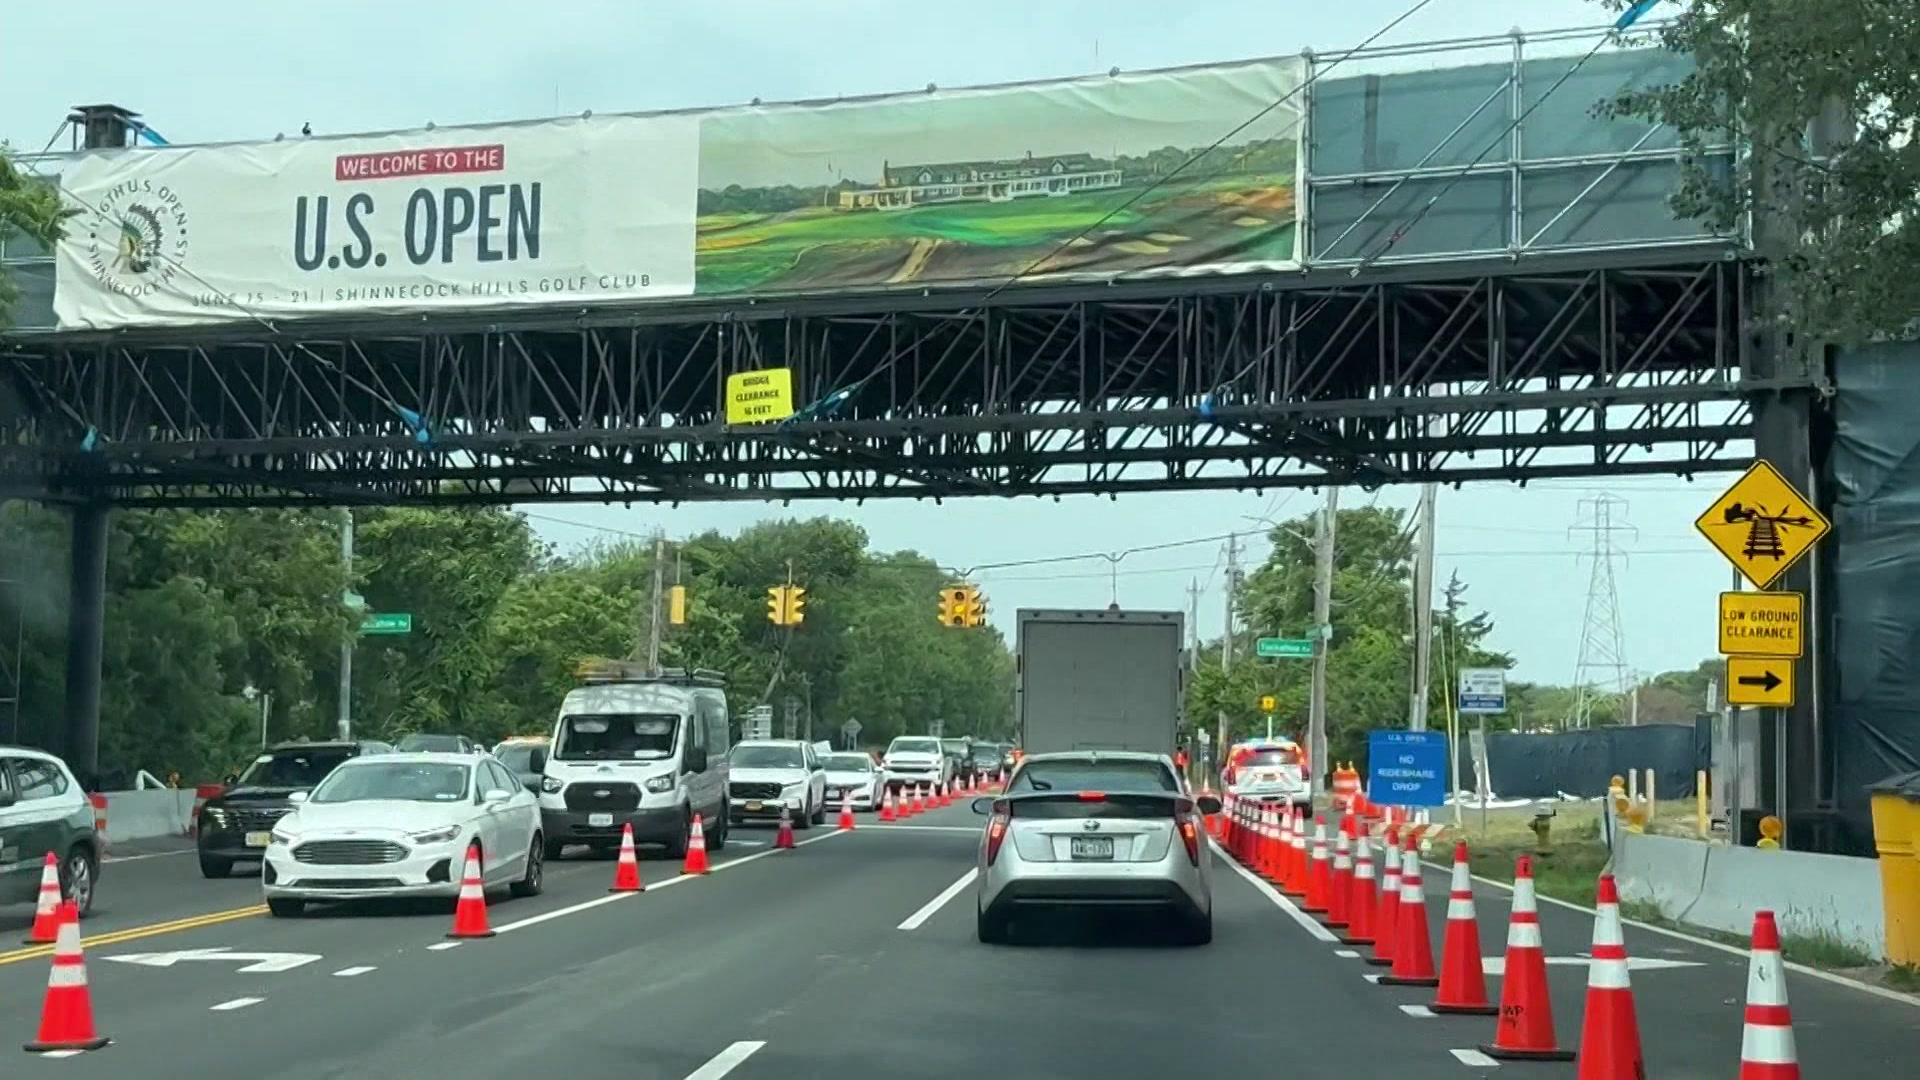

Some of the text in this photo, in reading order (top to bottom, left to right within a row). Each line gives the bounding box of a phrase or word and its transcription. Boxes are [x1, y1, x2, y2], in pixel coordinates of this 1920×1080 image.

[342, 149, 499, 176] WELCOME TO THE
[158, 186, 189, 227] OPEN
[294, 181, 541, 271] U.S. OPEN
[192, 291, 237, 307] JUNE
[291, 290, 308, 303] 21
[335, 283, 460, 301] SHINNECOCK
[472, 279, 528, 295] HILLS
[539, 275, 587, 293] GOLF
[599, 273, 650, 289] CLUB
[736, 390, 779, 402] CLEARANCE
[1723, 609, 1798, 623] LOW GROUND
[1726, 625, 1794, 639] CLEARANCE
[1399, 754, 1415, 765] NO
[1392, 783, 1421, 791] DROP
